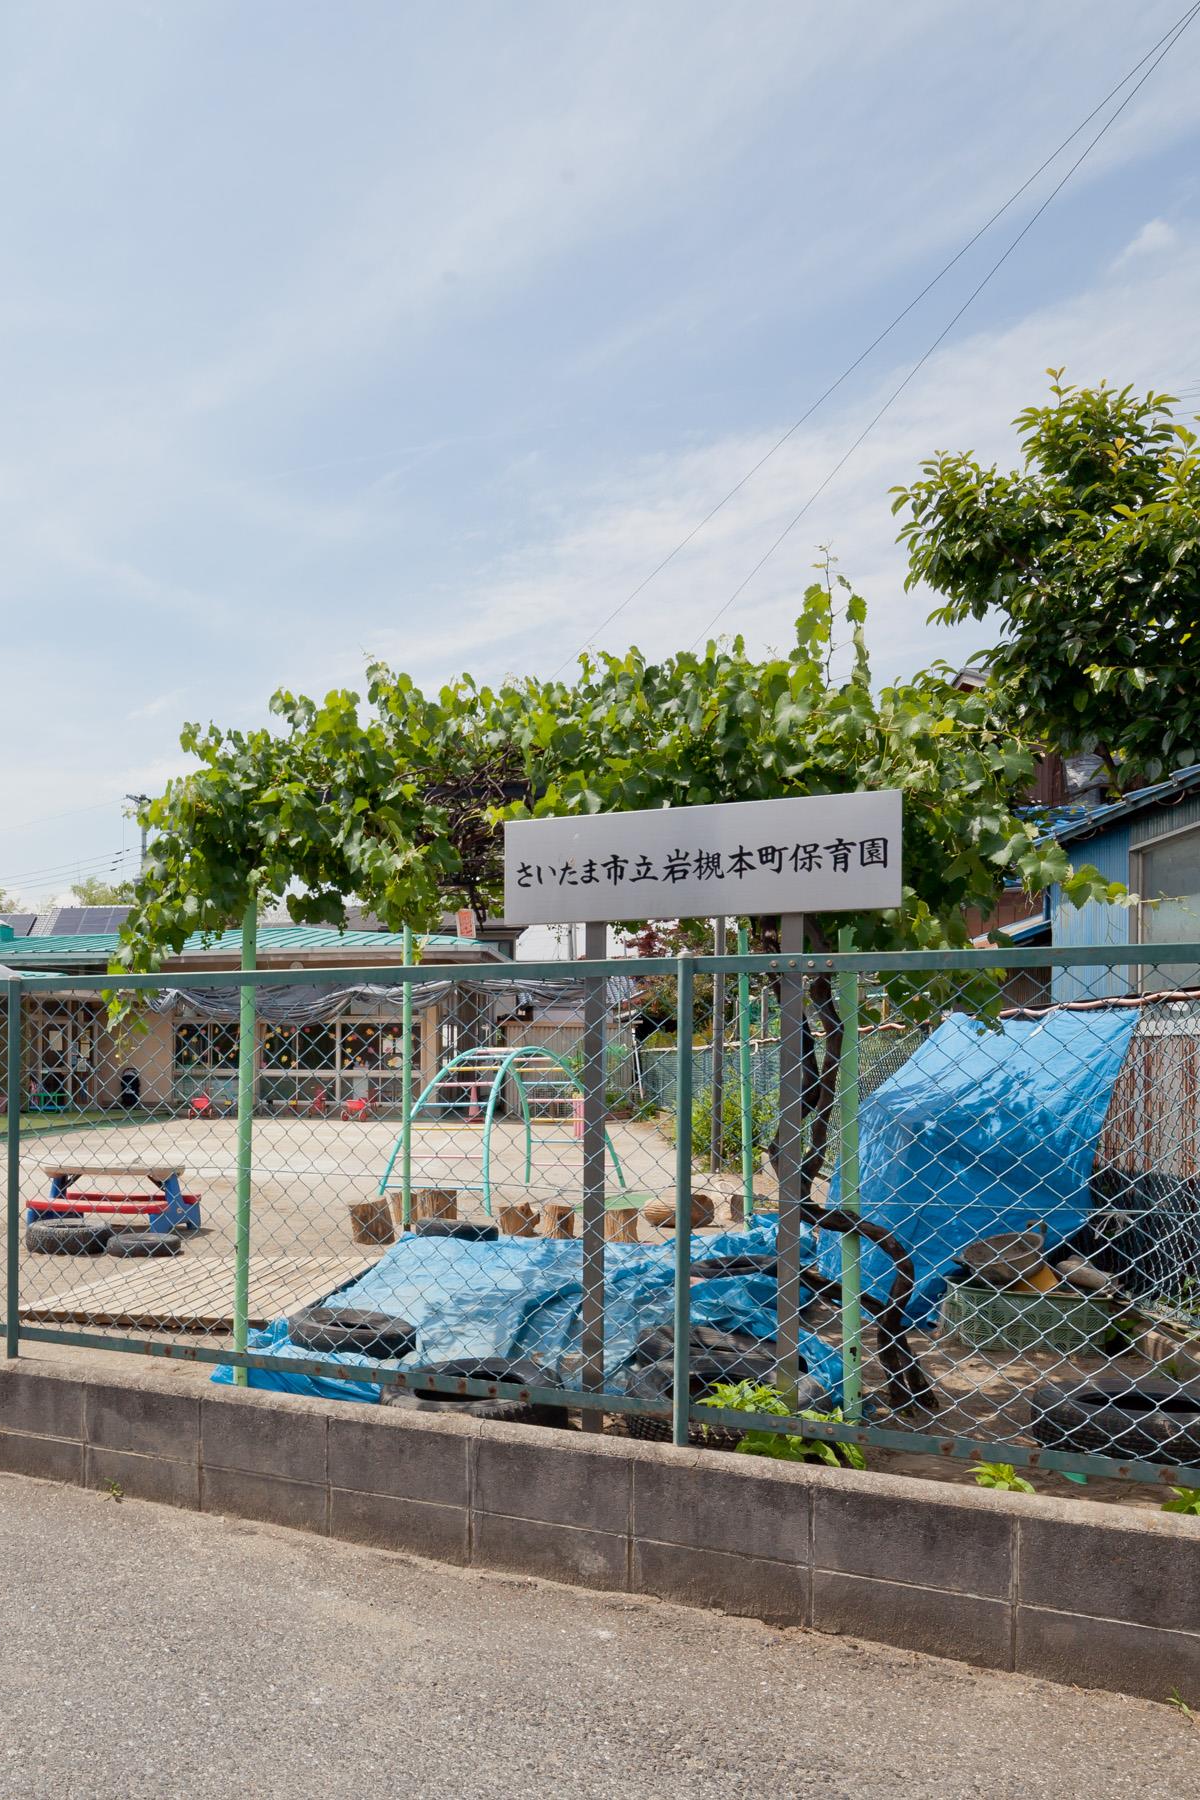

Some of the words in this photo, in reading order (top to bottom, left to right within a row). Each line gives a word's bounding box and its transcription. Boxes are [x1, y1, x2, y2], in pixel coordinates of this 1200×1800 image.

[515, 837, 889, 888] さいたま市立岩槻本町保育園
